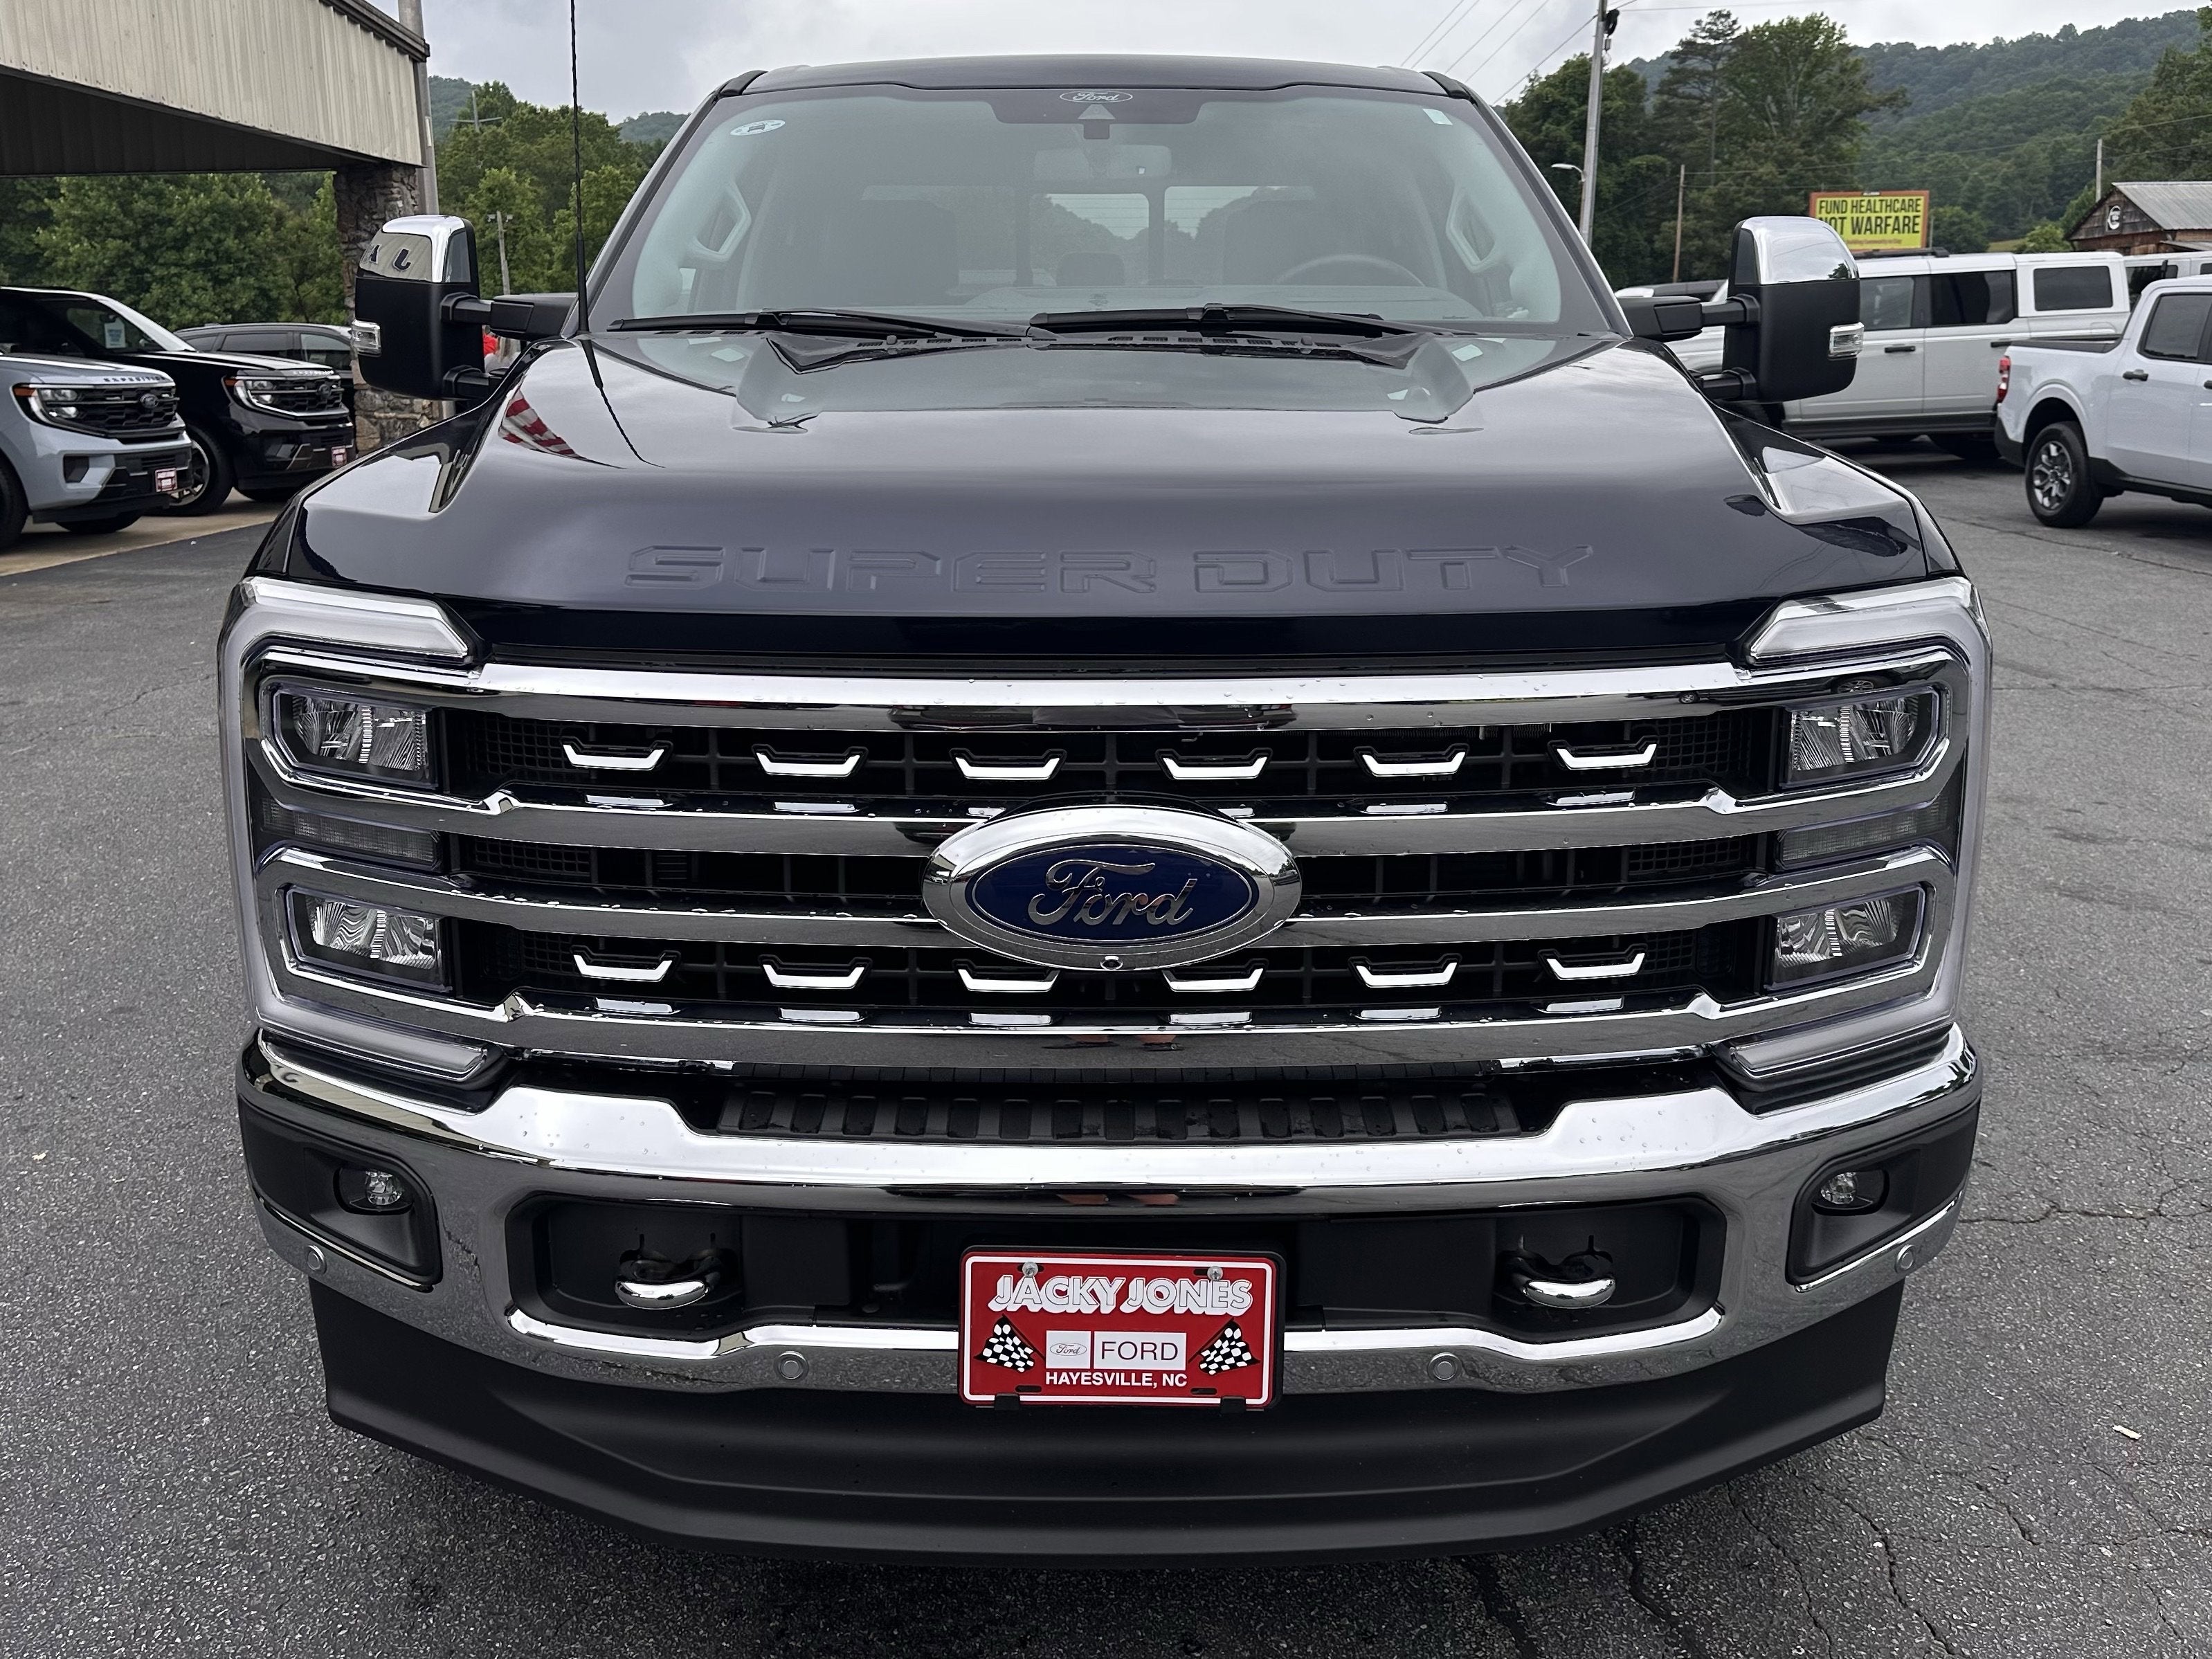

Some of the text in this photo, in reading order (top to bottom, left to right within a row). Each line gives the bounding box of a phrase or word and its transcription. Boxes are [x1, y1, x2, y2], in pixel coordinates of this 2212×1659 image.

[1073, 91, 1119, 101] Ford
[1819, 198, 1921, 215] FUND HEALTHCARE
[1851, 215, 1920, 235] WARFARE
[624, 544, 1593, 594] SUPER DUTY
[1028, 859, 1198, 926] Ford
[988, 1274, 1253, 1317] JACKY JONES
[1055, 1340, 1179, 1361] Ford FORD
[1046, 1371, 1188, 1389] HAYESVILLE, NC
